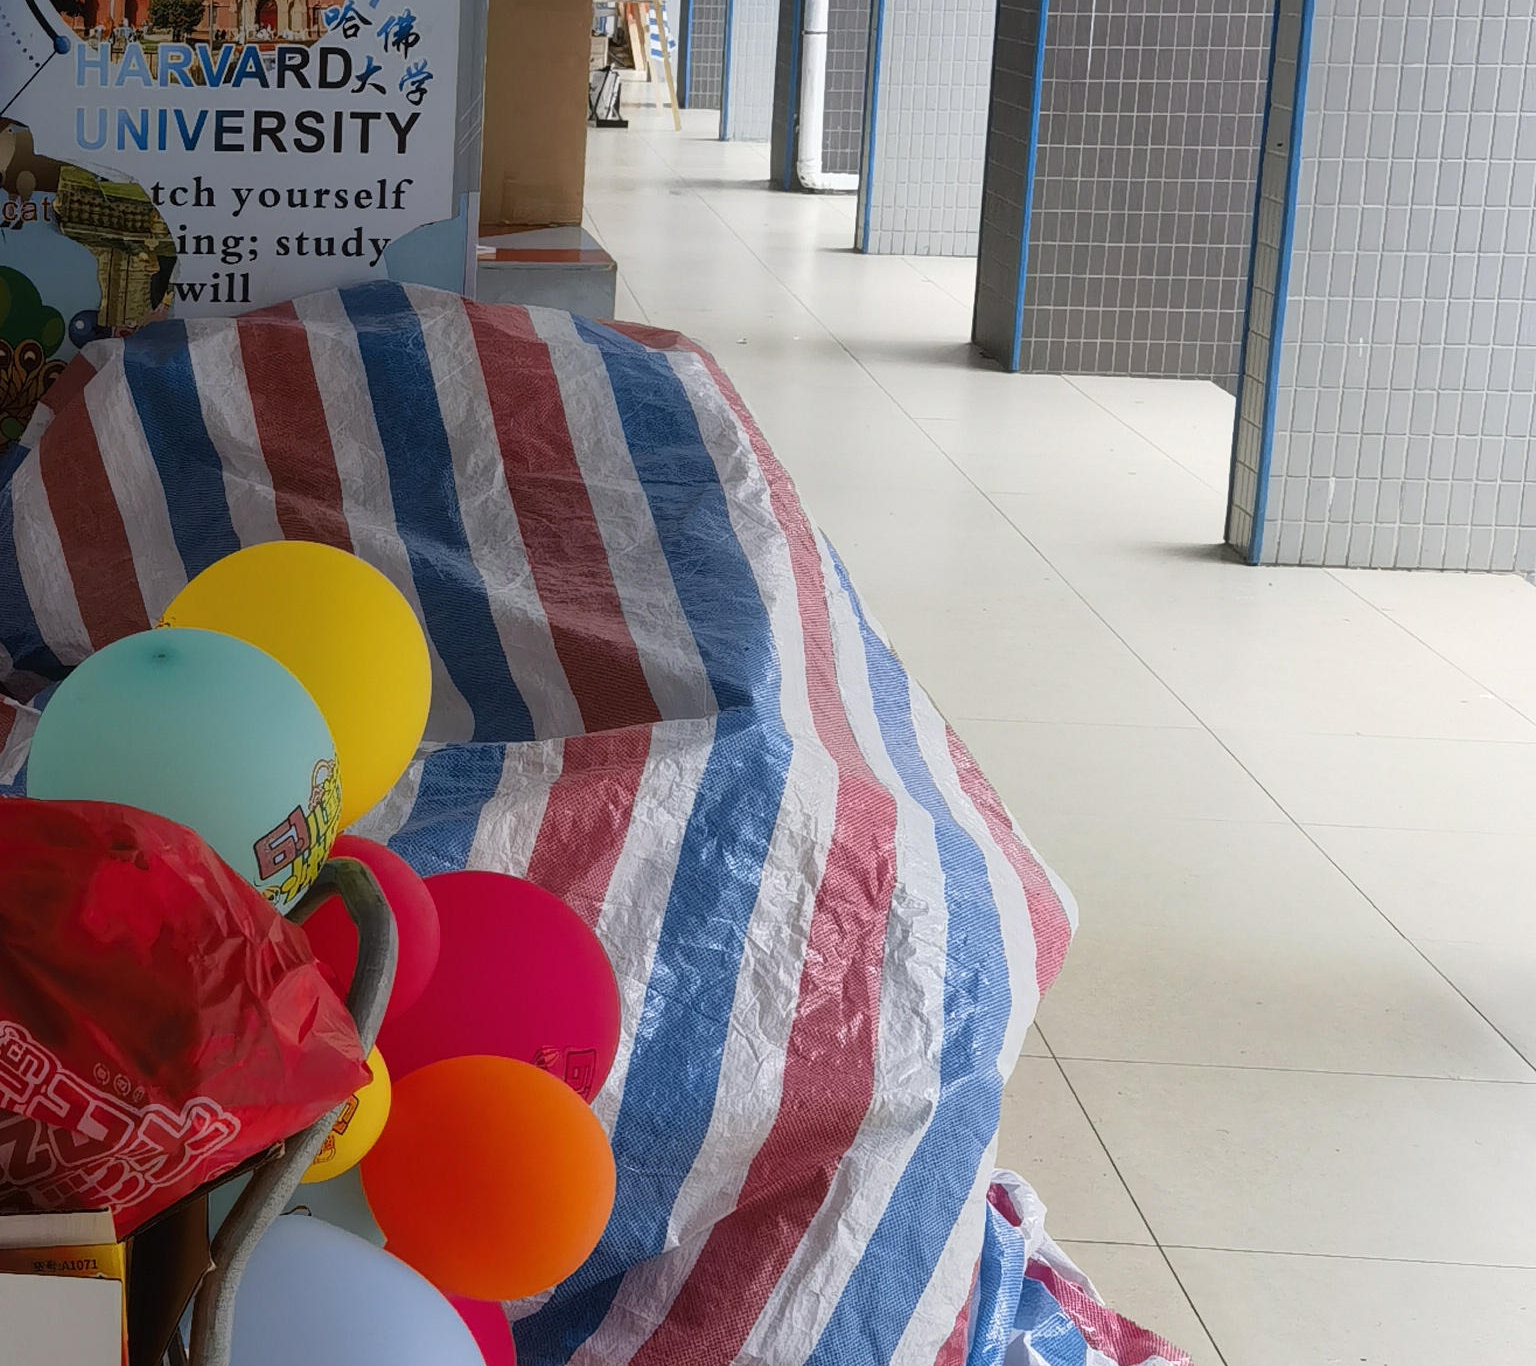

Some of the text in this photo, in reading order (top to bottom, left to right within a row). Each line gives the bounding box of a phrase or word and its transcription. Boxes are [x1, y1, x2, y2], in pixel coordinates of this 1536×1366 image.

[75, 45, 352, 89] HARVARD
[75, 108, 422, 155] UNIVERSITY
[3, 197, 51, 221] cat
[231, 178, 414, 217] yourself
[275, 227, 392, 267] study
[174, 272, 251, 303] will
